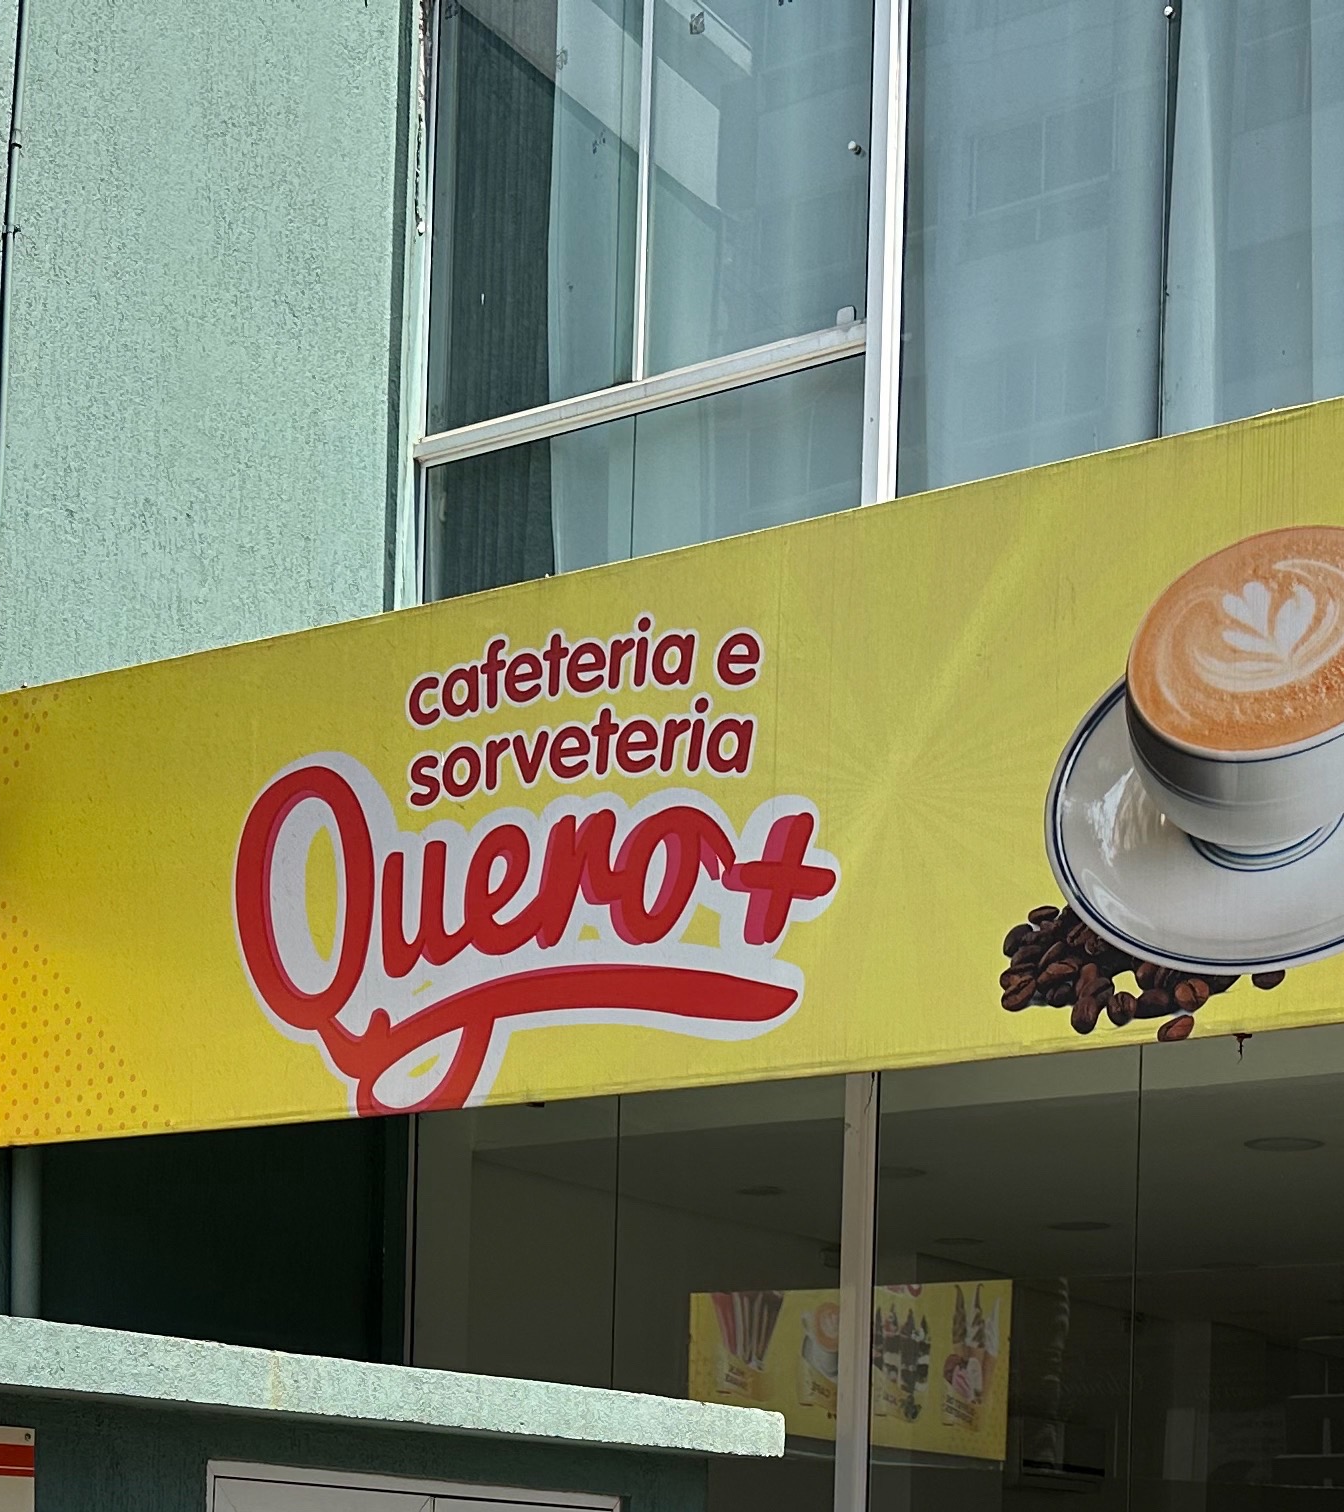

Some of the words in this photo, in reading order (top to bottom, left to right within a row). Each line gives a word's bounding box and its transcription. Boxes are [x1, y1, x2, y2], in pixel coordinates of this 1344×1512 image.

[407, 616, 695, 727] cafeteria
[716, 629, 760, 686] e
[407, 697, 754, 807] sorveteria
